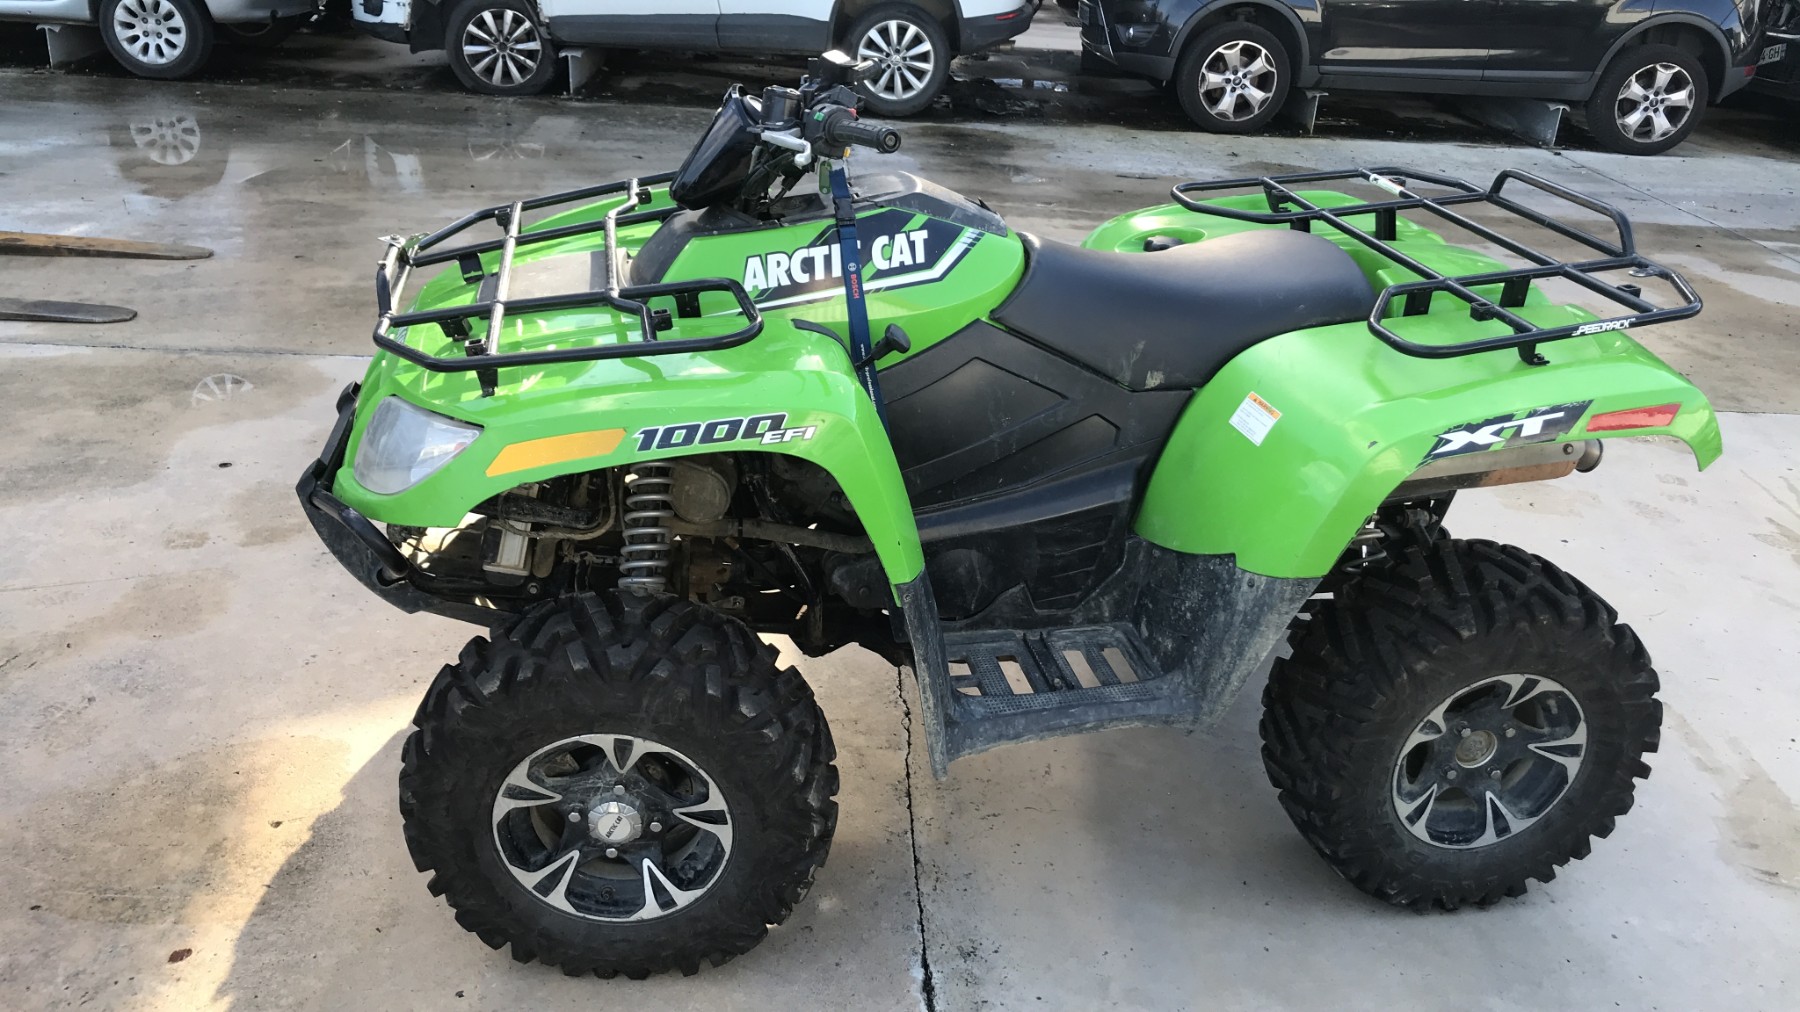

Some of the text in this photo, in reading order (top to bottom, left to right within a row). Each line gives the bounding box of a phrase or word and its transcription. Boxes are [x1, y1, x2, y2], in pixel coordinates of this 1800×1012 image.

[743, 229, 928, 292] ARCTI CAT
[850, 274, 860, 299] BOSCH
[635, 413, 787, 451] 1000
[760, 426, 816, 445] EFI
[1432, 411, 1565, 454] XT
